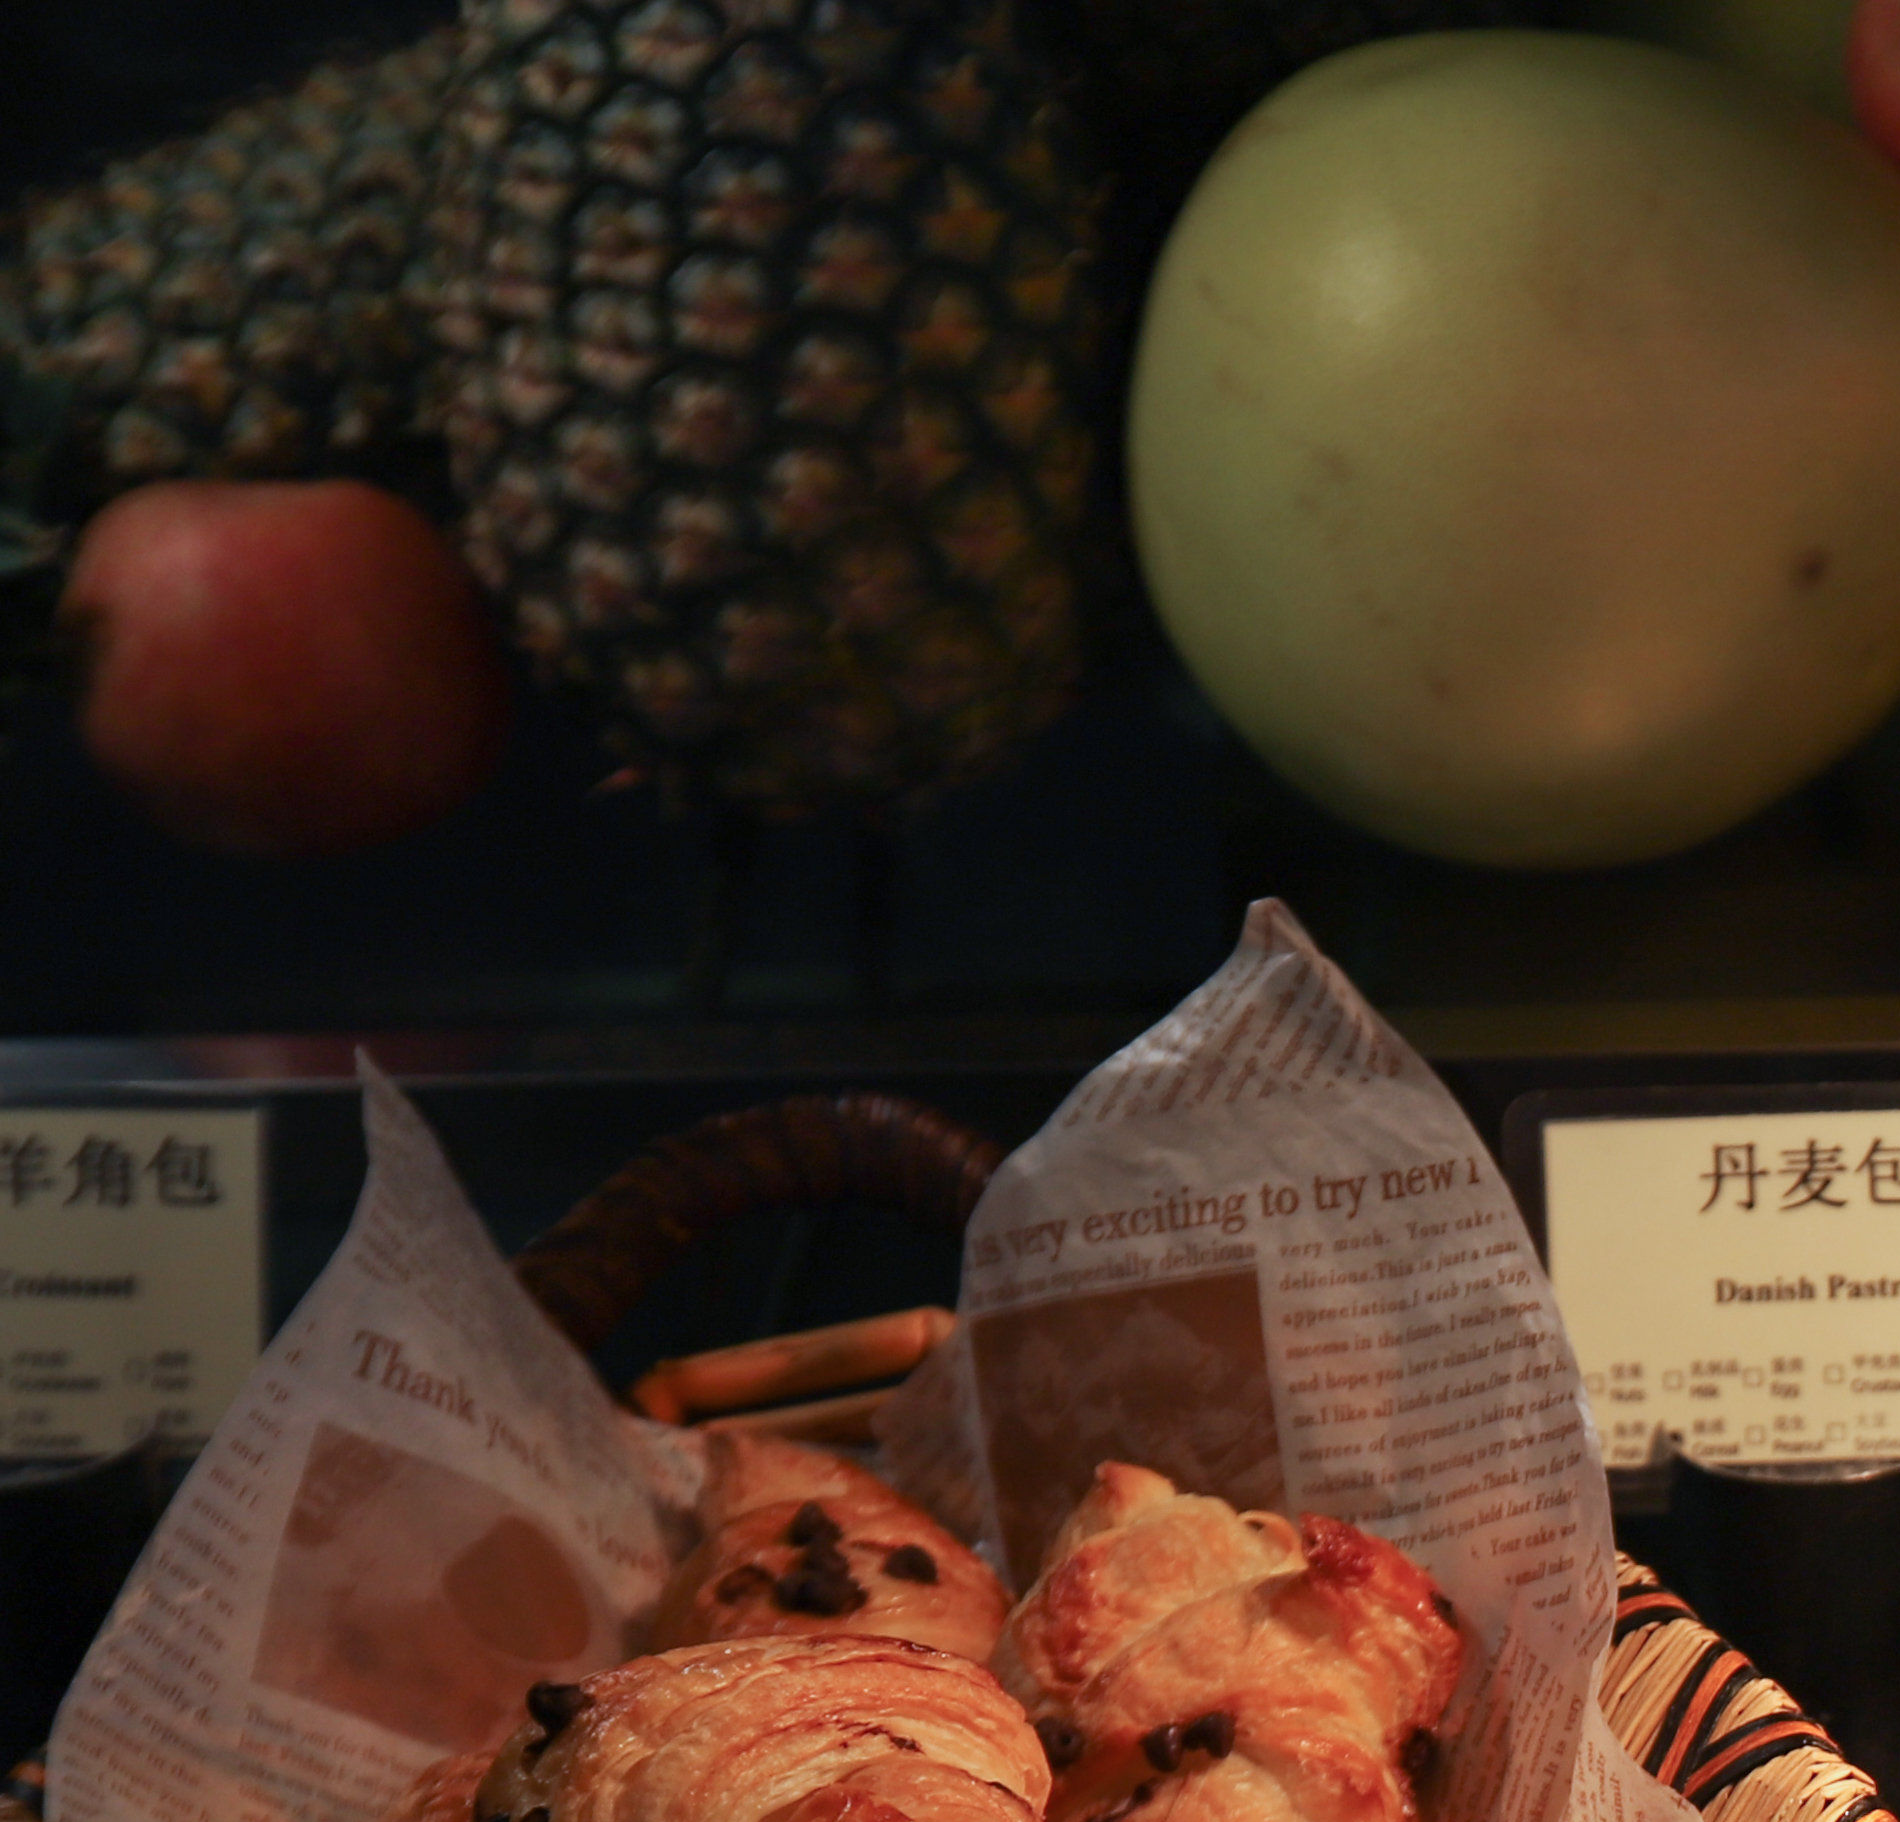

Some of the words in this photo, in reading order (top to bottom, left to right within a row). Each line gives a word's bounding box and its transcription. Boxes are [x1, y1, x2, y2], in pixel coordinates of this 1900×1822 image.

[0, 1134, 223, 1208] 羊角包
[1081, 1186, 1248, 1247] exciting
[1259, 1180, 1299, 1218] to
[1312, 1172, 1368, 1220] try
[1381, 1157, 1457, 1201] new
[1716, 1275, 1816, 1306] Danish
[354, 1329, 478, 1422] Thank
